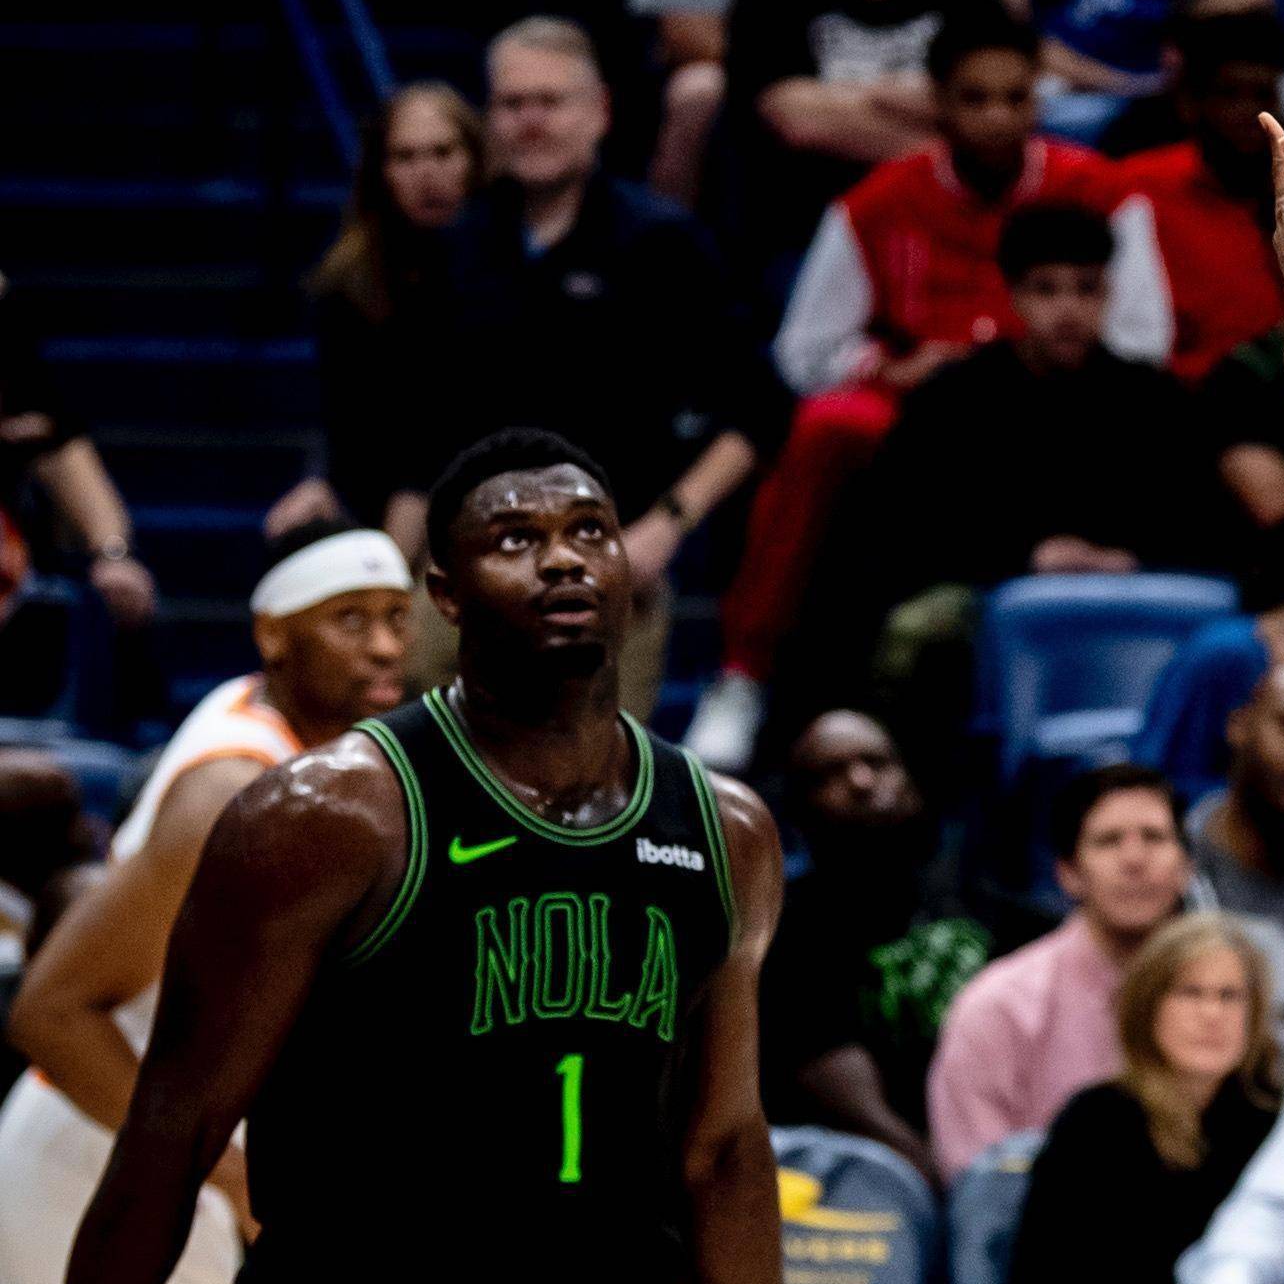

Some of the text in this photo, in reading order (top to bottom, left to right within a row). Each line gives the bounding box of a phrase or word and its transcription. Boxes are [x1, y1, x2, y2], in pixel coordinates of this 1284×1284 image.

[635, 837, 705, 872] ibotta
[470, 891, 679, 1042] NOLA
[555, 1053, 584, 1183] 1
